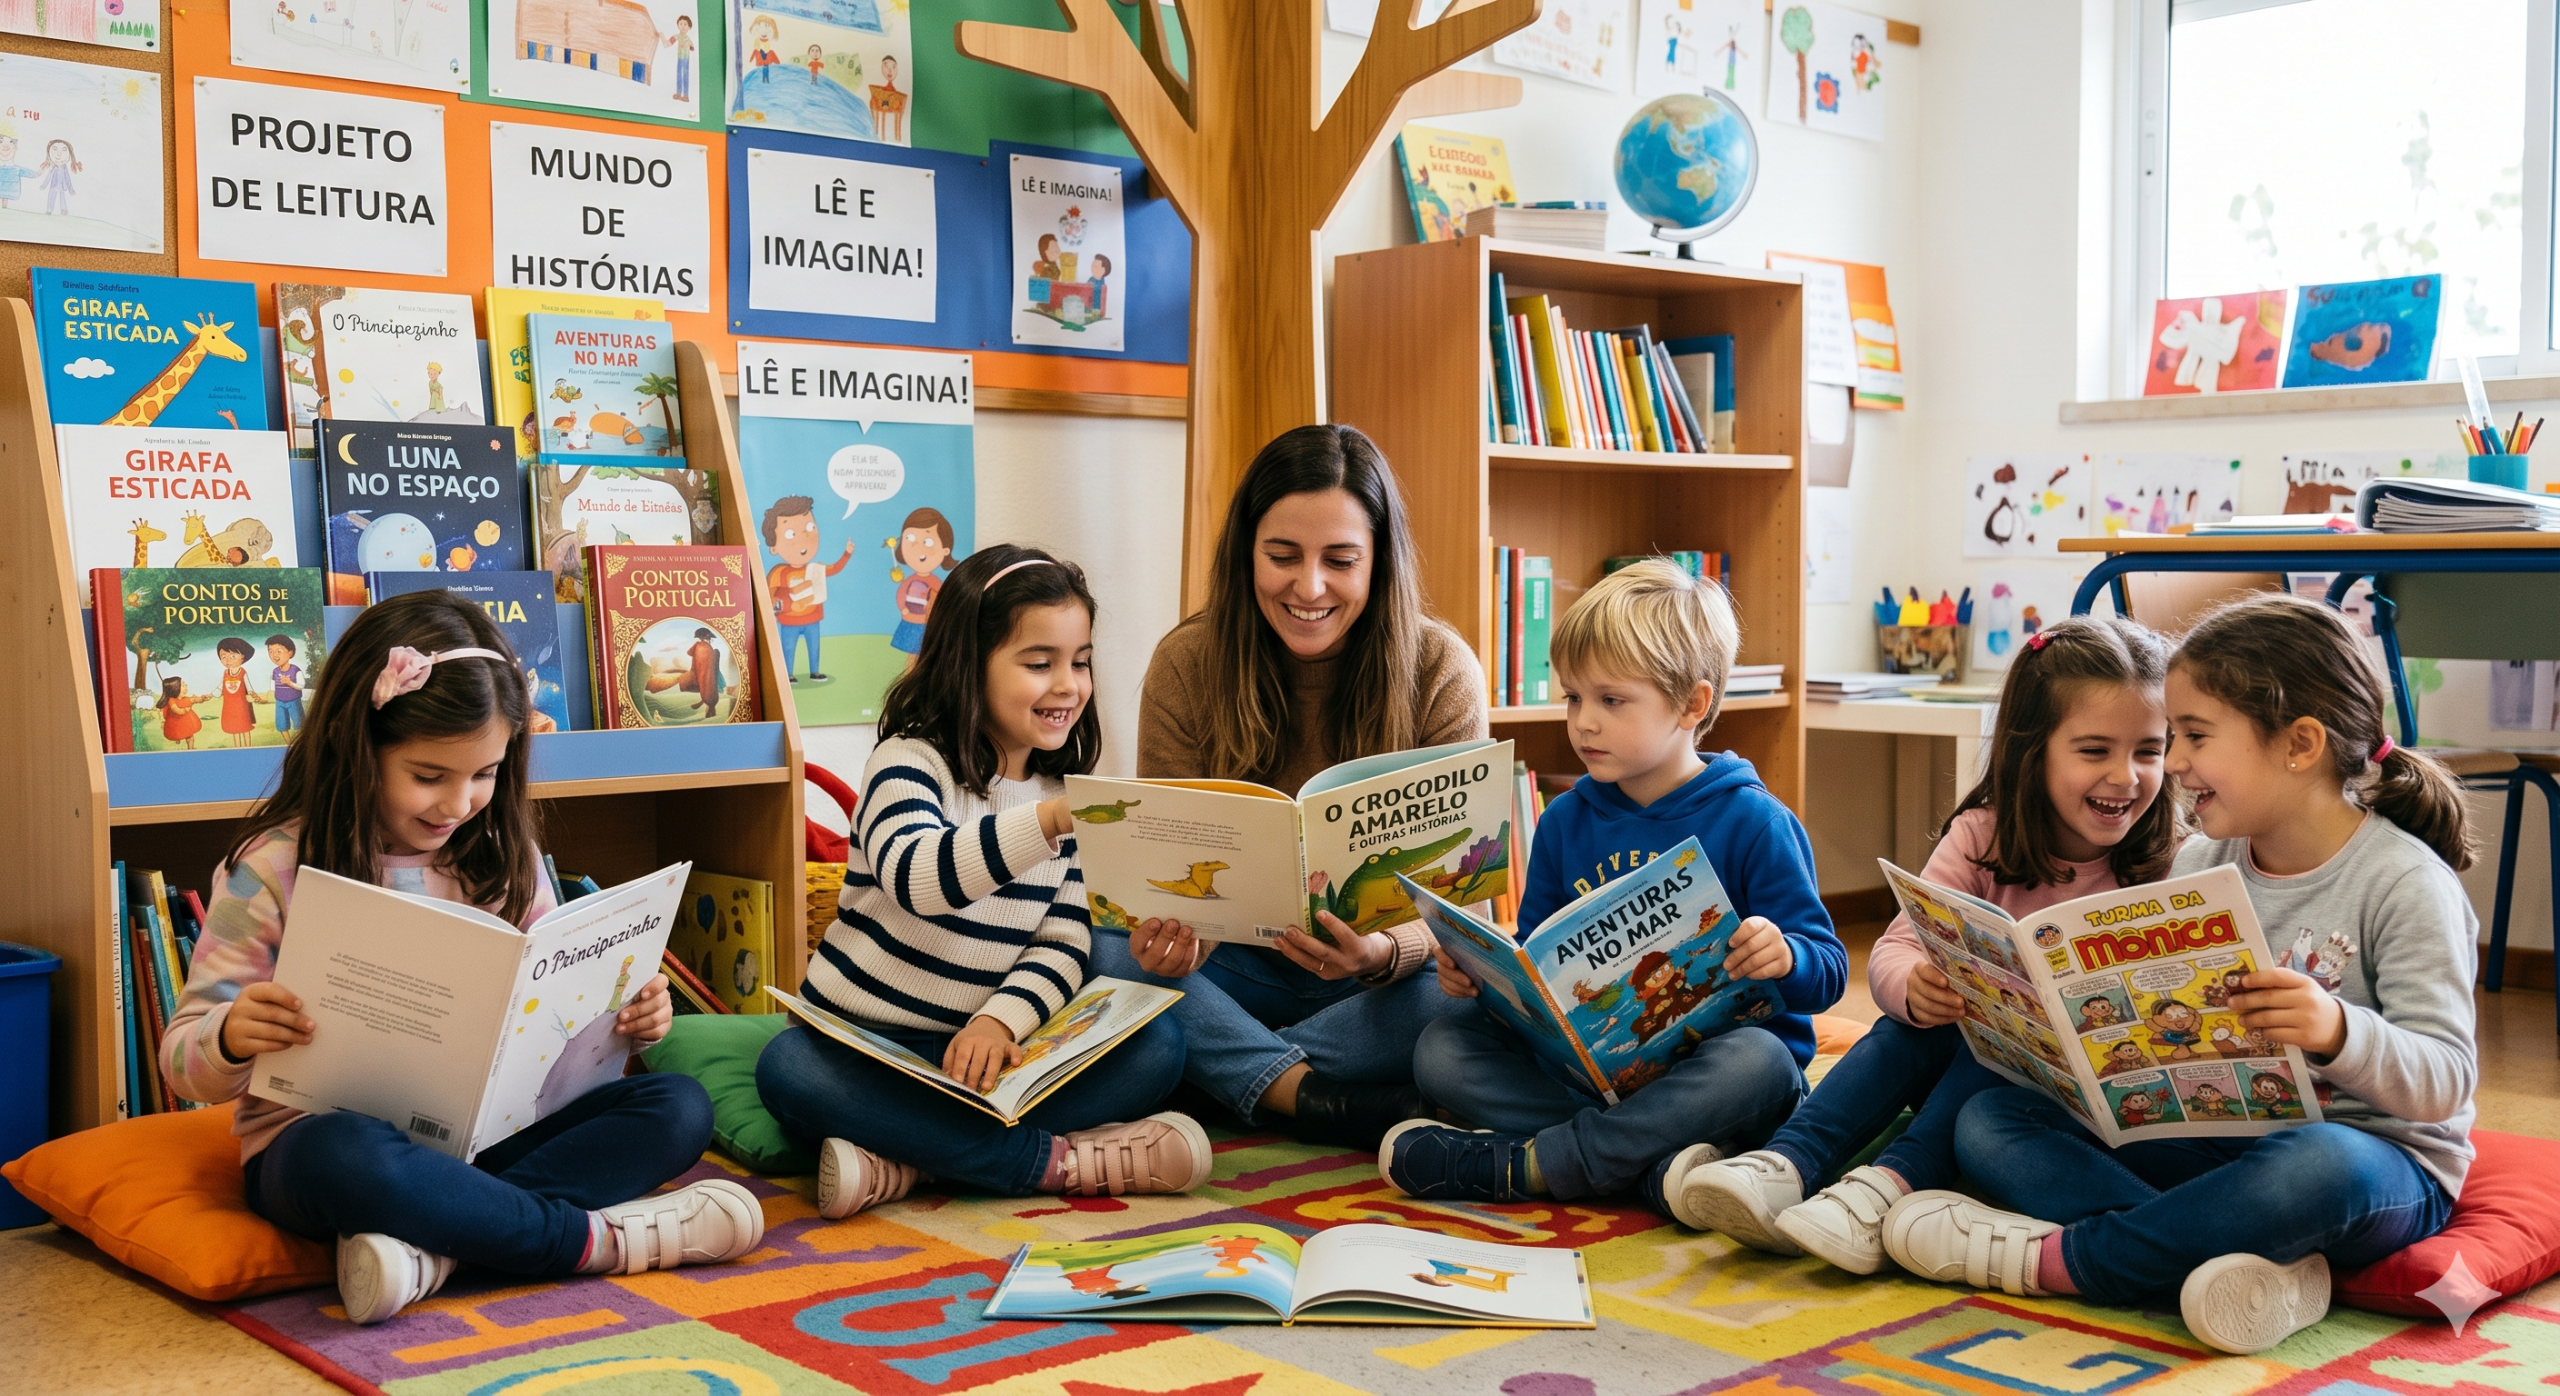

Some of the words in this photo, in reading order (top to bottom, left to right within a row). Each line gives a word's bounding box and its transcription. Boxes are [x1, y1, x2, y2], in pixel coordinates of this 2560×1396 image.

[231, 113, 412, 162] PROJETO
[531, 146, 672, 188] MUNDO
[212, 176, 262, 211] DE
[277, 181, 435, 225] LEITURA
[815, 178, 847, 216] LÊ
[860, 189, 875, 218] E
[1022, 176, 1036, 192] LÊ
[1040, 181, 1046, 194] E
[1051, 182, 1112, 201] IMAGINA!
[582, 206, 625, 237] DE
[764, 235, 923, 278] IMAGINA!
[512, 253, 694, 297] HISTÓRIAS
[63, 297, 150, 321] GIRAFA
[65, 321, 180, 344] ESTICADA
[333, 313, 345, 331] O
[348, 313, 459, 341] Principezinho
[554, 330, 657, 350] AVENTURAS
[574, 351, 598, 366] NO
[603, 352, 638, 367] MAR
[746, 358, 778, 395] LÊ
[792, 368, 807, 396] E
[819, 369, 968, 404] IMAGINA!
[125, 449, 233, 473] GIRAFA
[387, 445, 462, 470] LUNA
[109, 476, 252, 500] ESTICADA
[347, 472, 390, 496] NO
[398, 474, 500, 503] ESPAÇO
[624, 499, 637, 512] de
[162, 583, 261, 601] CONTOS
[269, 589, 289, 600] DE
[630, 570, 709, 586] CONTOS
[714, 577, 728, 586] DE
[623, 586, 736, 608] PORTUGAL
[163, 605, 293, 624] PORTUGAL
[1325, 804, 1343, 823] O
[1351, 763, 1489, 815] CROCODILO
[1349, 791, 1467, 839] AMARELO
[1349, 842, 1355, 852] E
[1359, 828, 1406, 849] OUTRAS
[1409, 810, 1467, 835] HISTÓRIAS
[1556, 866, 1693, 965] AVENTURAS
[2084, 899, 2165, 927] TURMA
[2169, 890, 2206, 910] DA
[532, 958, 547, 981] O
[550, 914, 662, 975] Principezinho
[1586, 939, 1622, 971] NO
[1626, 902, 1682, 947] MAR
